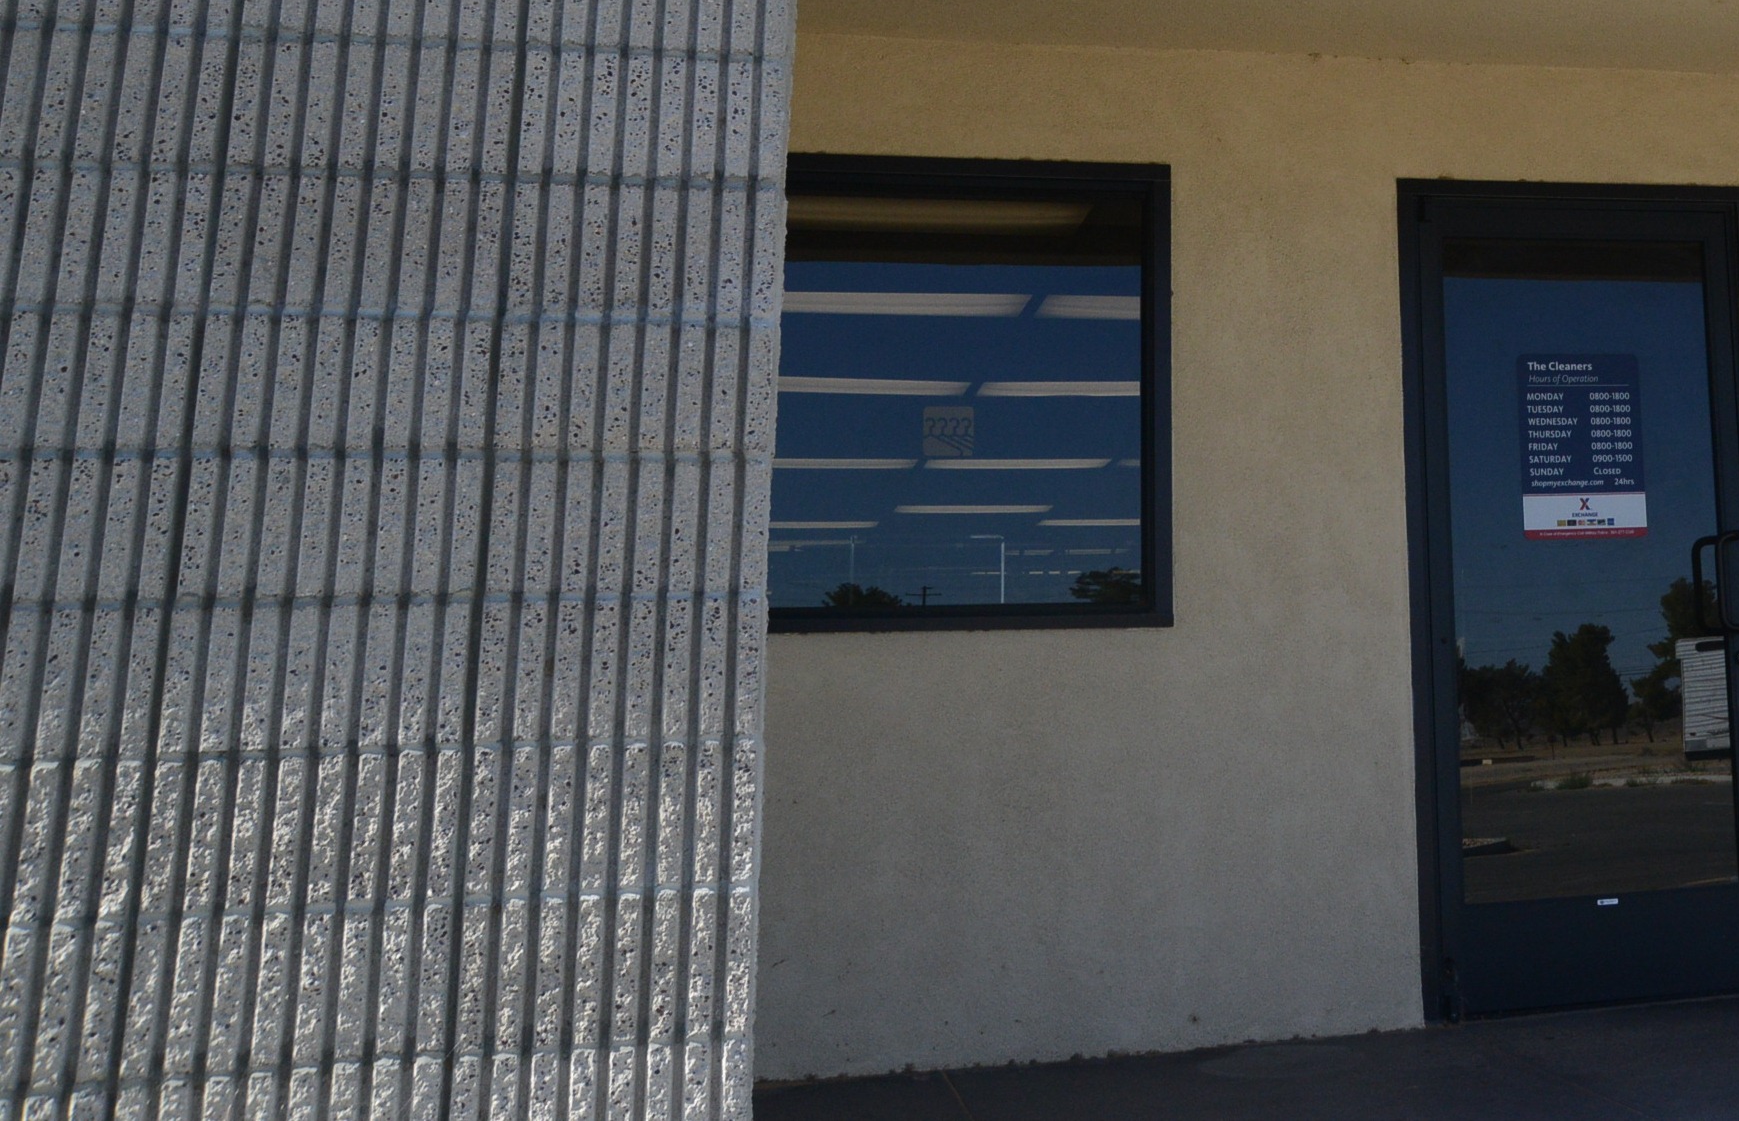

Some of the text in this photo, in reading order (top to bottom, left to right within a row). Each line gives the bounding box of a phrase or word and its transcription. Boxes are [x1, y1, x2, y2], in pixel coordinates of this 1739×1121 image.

[1527, 362, 1592, 370] The Cleaners
[1553, 374, 1560, 385] of
[1562, 375, 1598, 385] Operation
[1589, 392, 1630, 400] 0800-1800
[1527, 405, 1563, 413] TUESDAY
[1528, 430, 1572, 438] THURSDAY
[1591, 442, 1632, 450] 0800-1800
[1529, 455, 1572, 463] SATURDAY
